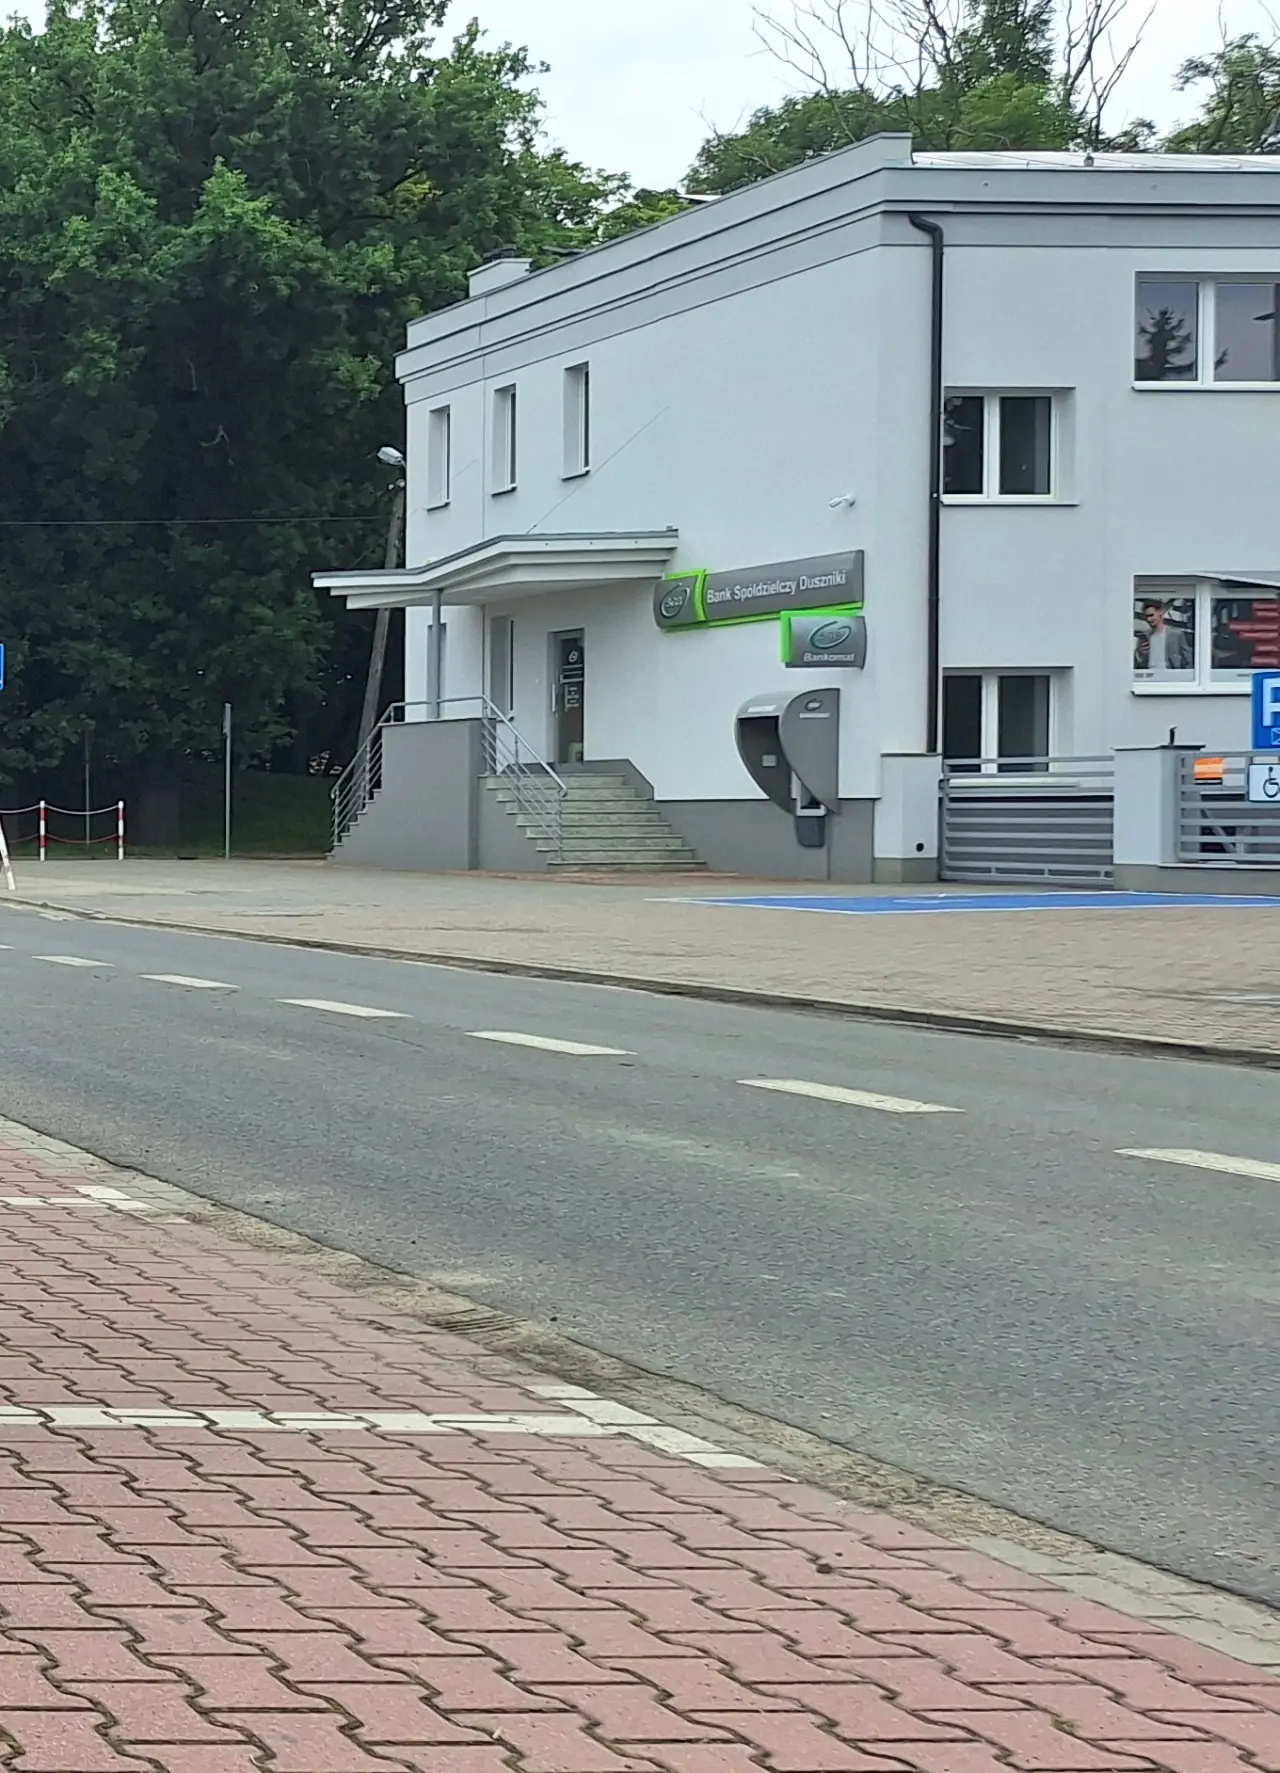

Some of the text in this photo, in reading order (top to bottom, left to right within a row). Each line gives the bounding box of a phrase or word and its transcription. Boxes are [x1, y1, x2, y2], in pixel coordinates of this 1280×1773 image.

[706, 587, 733, 604] Bank
[799, 570, 847, 590] Duszniki
[803, 652, 855, 662] Bankomat
